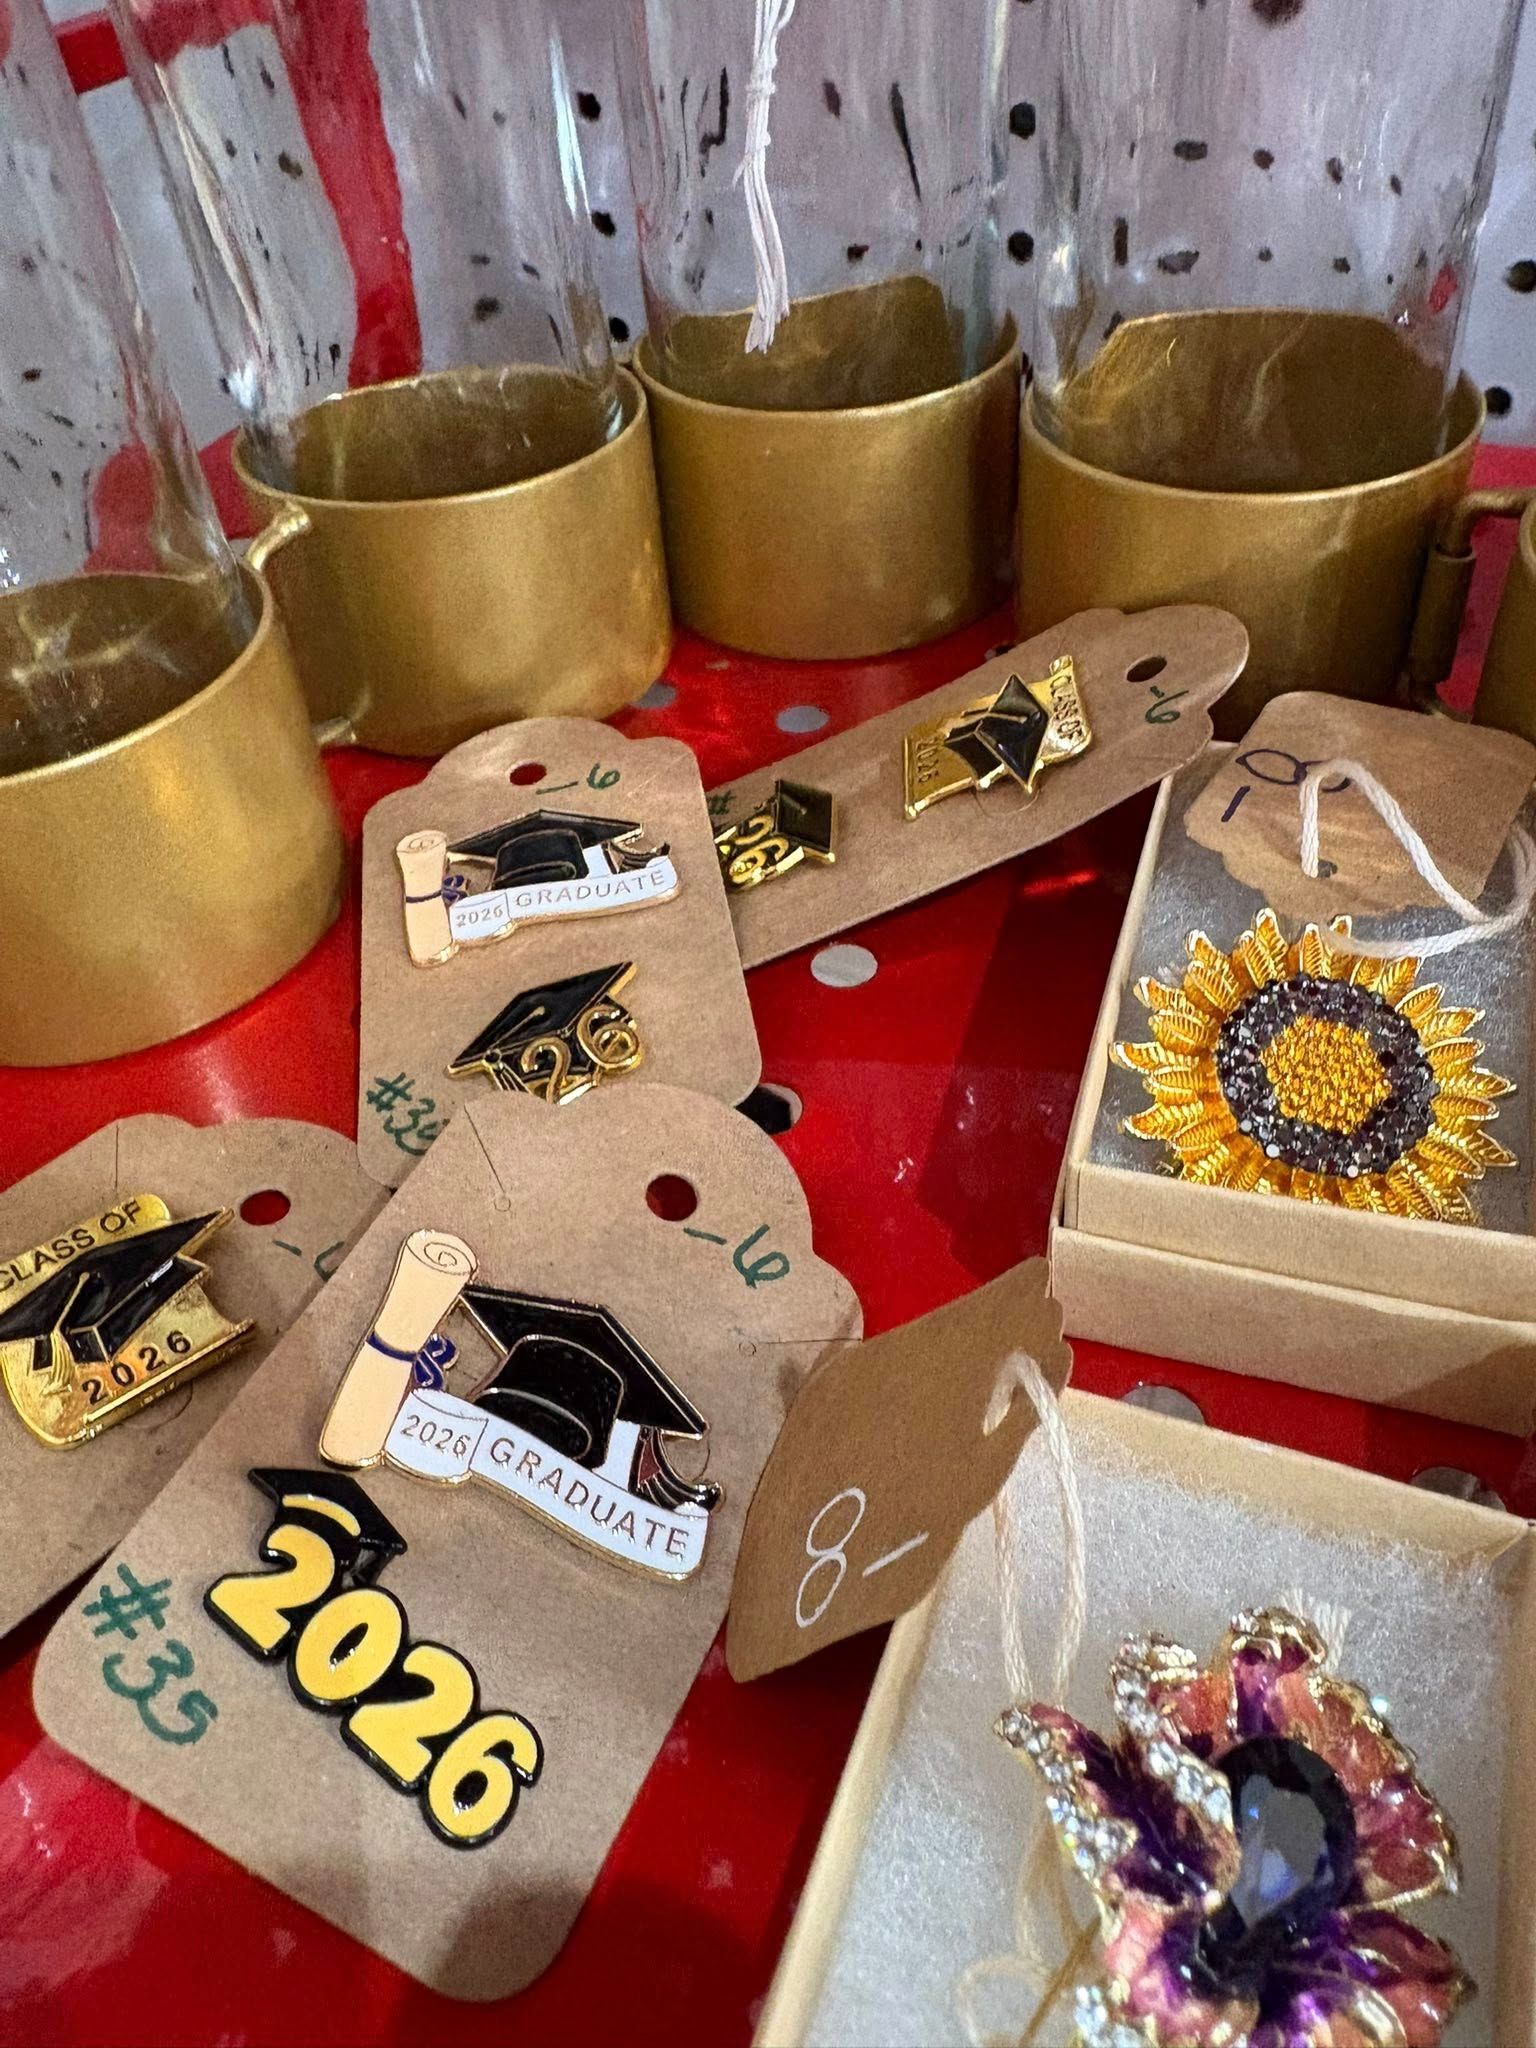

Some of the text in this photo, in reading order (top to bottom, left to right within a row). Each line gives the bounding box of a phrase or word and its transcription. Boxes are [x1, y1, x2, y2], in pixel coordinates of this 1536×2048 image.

[455, 868, 667, 929] 2026 GRADUATE
[0, 1199, 142, 1292] CLASS OF
[81, 1329, 192, 1406] 2026
[400, 1413, 692, 1564] 2026 GRADUATE
[82, 1563, 219, 1746] #35
[206, 1523, 541, 1846] 2026
